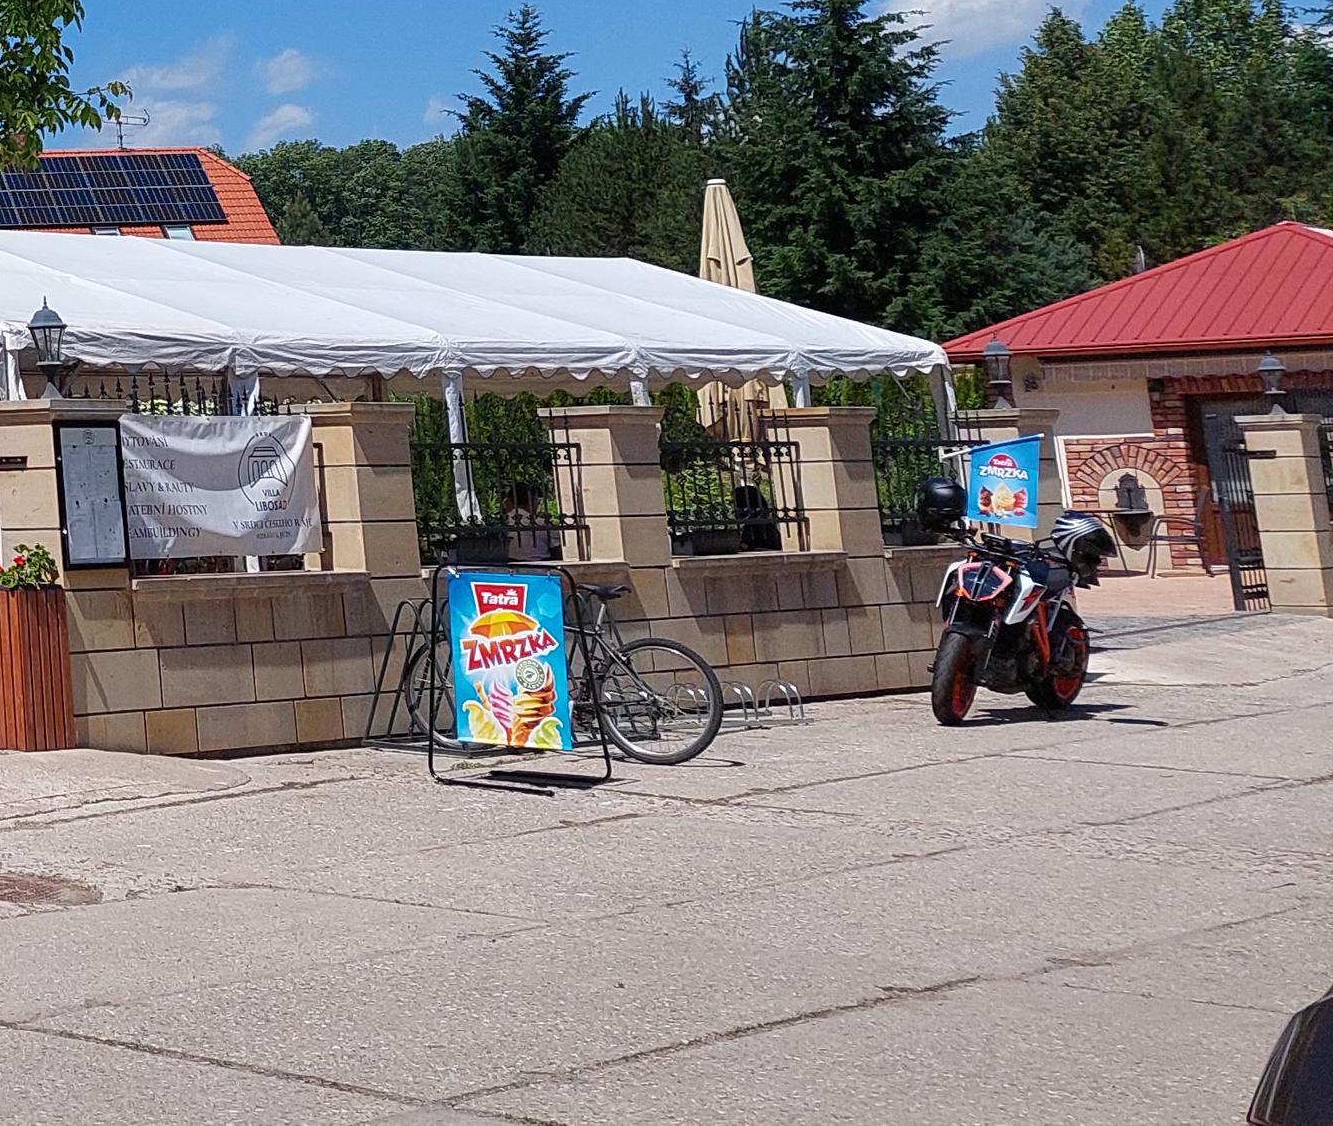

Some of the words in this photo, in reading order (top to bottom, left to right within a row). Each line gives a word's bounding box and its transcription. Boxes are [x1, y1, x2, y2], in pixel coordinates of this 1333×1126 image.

[979, 466, 1029, 480] ZMRZKA
[125, 482, 155, 492] SLAVY
[158, 482, 164, 492] &
[262, 489, 281, 497] VILLA
[168, 504, 208, 515] HOSTINY
[255, 500, 288, 512] LIBOSAD
[481, 591, 518, 606] Tatra
[463, 632, 556, 671] ZMRZKA
